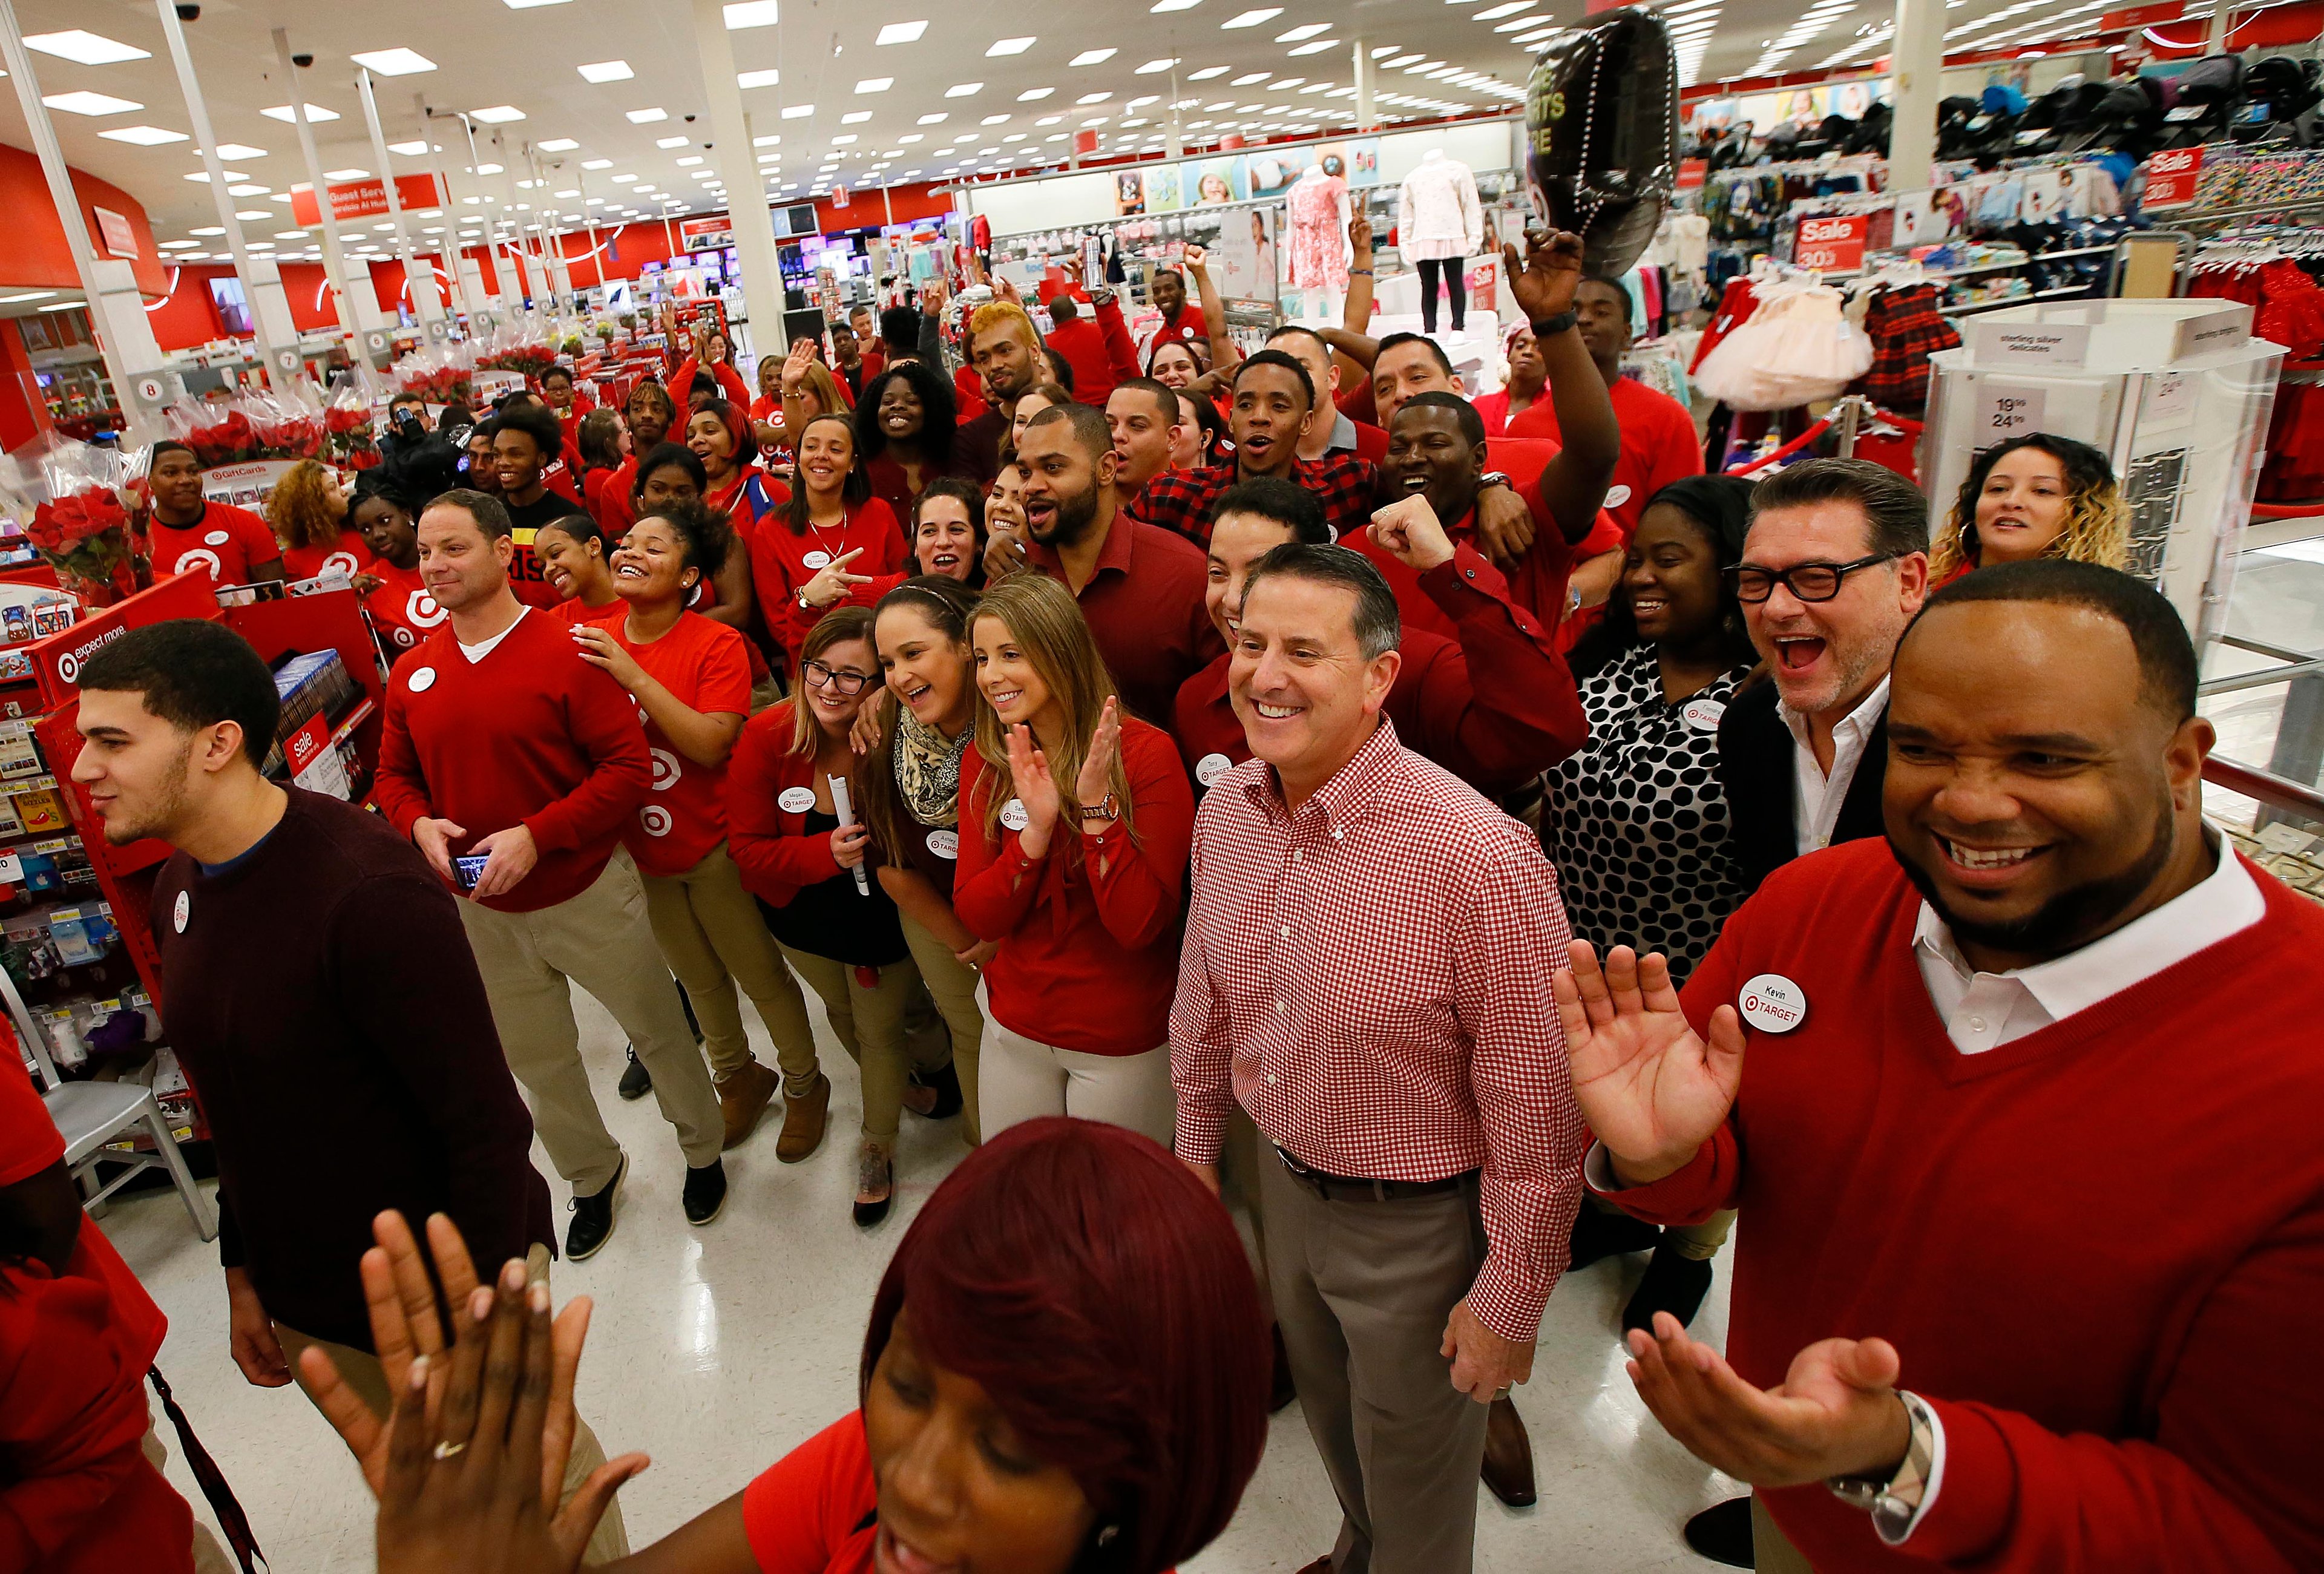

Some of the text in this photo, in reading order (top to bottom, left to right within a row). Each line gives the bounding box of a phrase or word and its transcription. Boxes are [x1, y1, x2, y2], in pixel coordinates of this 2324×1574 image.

[2150, 151, 2193, 174] Sale
[329, 185, 400, 203] Guest Serve
[1800, 221, 1853, 243] Sale
[1475, 265, 1494, 287] Sale
[284, 355, 293, 366] 7
[146, 384, 156, 396] 8
[222, 465, 266, 479] GiftCards
[74, 625, 126, 659] expect more.
[294, 731, 313, 758] sale
[1209, 767, 1229, 778] TARGET
[940, 835, 957, 845] Ashley
[940, 844, 959, 853] TARG
[1765, 985, 1785, 1000] Kevin
[1759, 1002, 1797, 1022] TARGET
